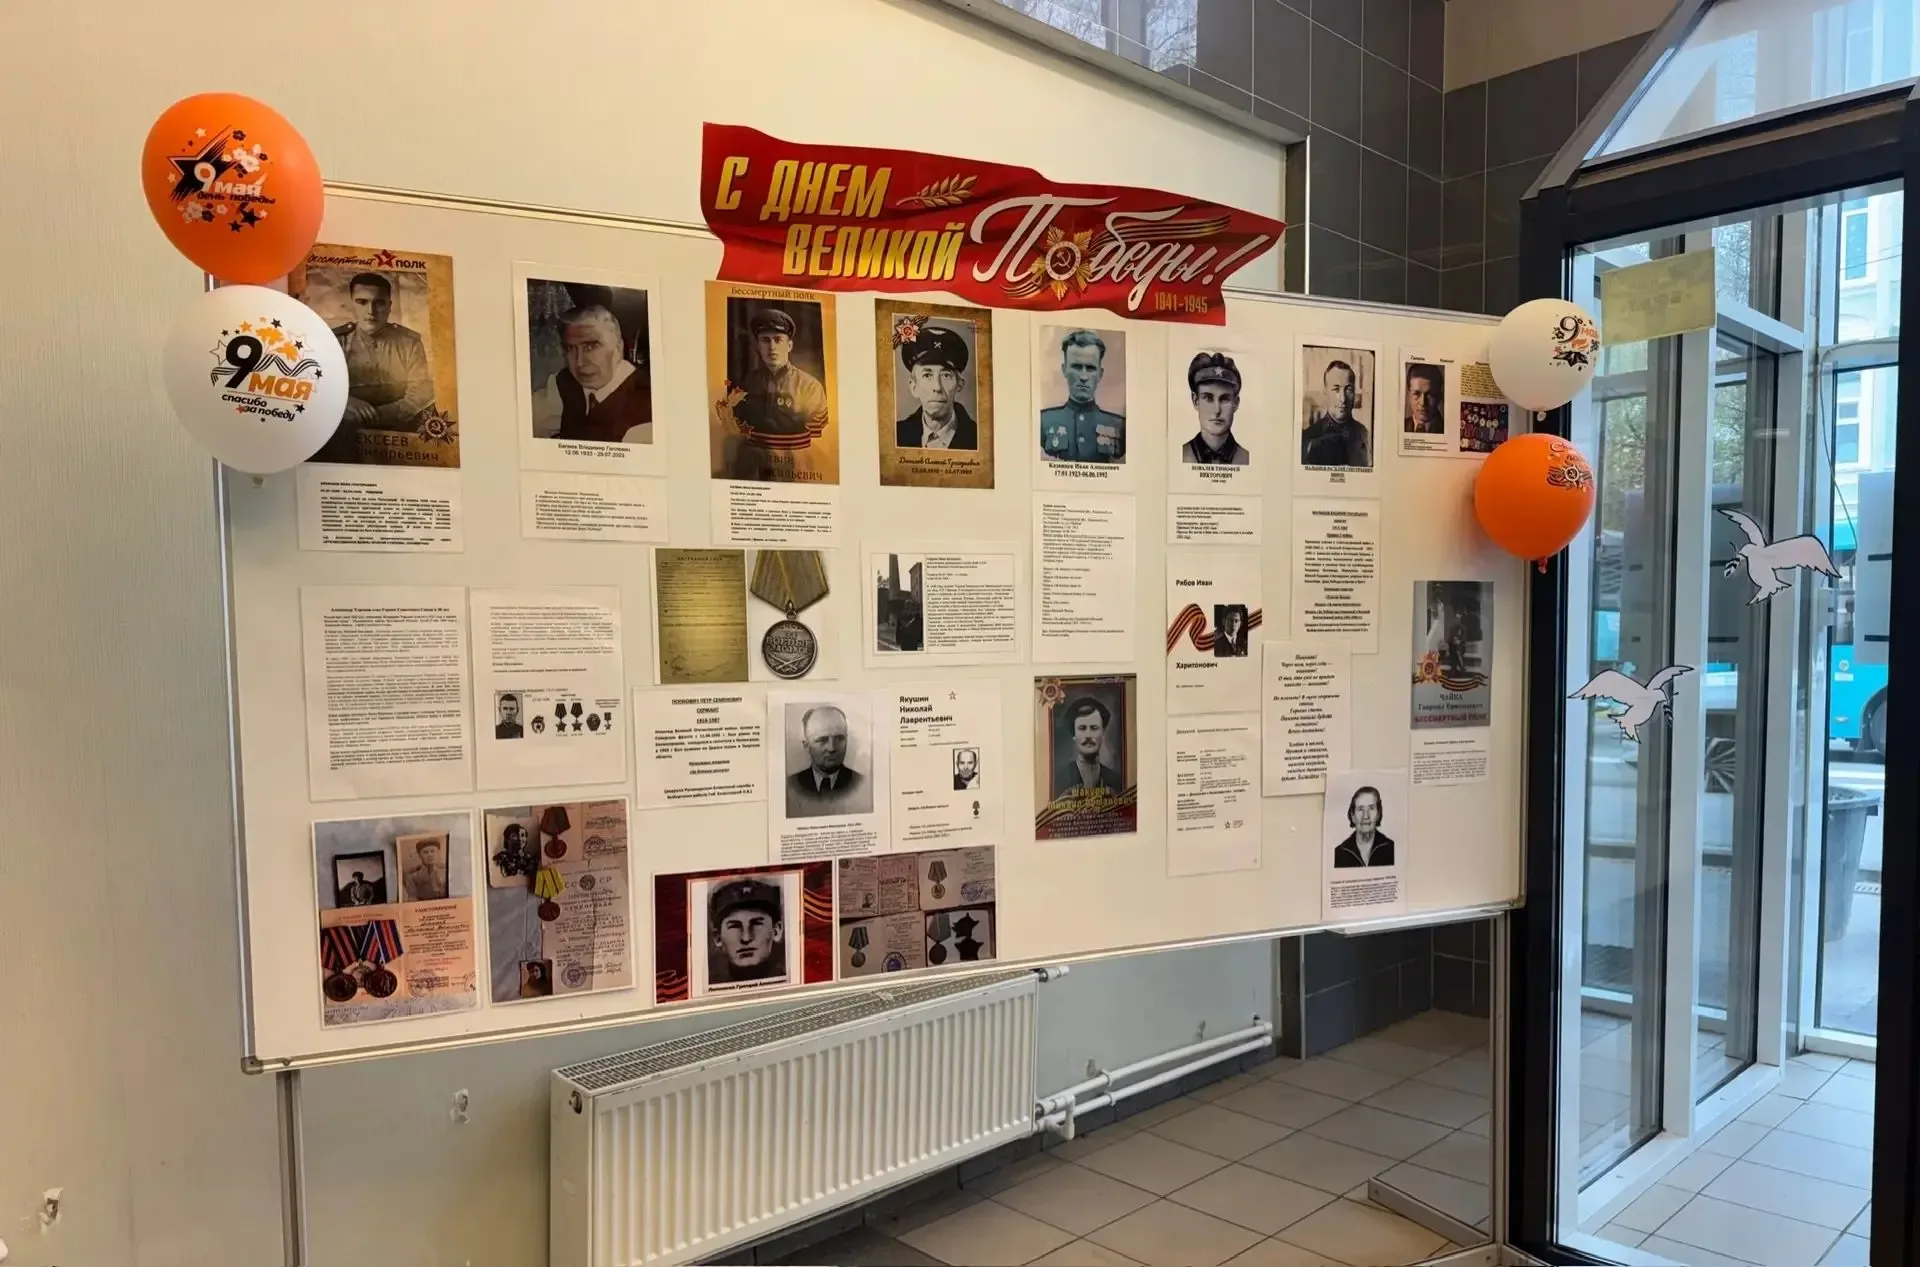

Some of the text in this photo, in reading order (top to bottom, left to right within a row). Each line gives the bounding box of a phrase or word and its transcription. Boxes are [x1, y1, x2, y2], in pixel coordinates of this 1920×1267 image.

[194, 162, 216, 191] 9
[715, 156, 892, 222] С ДНЕМ
[782, 222, 966, 282] ВЕЛИКОЙ
[1153, 292, 1209, 315] 1941-1945
[1557, 315, 1579, 344] 9
[225, 335, 313, 401] 9 мая
[221, 393, 268, 408] спасибо
[243, 405, 296, 422] за победу
[1196, 579, 1213, 587] Иван
[1175, 661, 1218, 670] Харитонович
[899, 695, 929, 704] Якушин
[899, 704, 933, 713] Николай
[899, 715, 953, 725] Лаврентьевич
